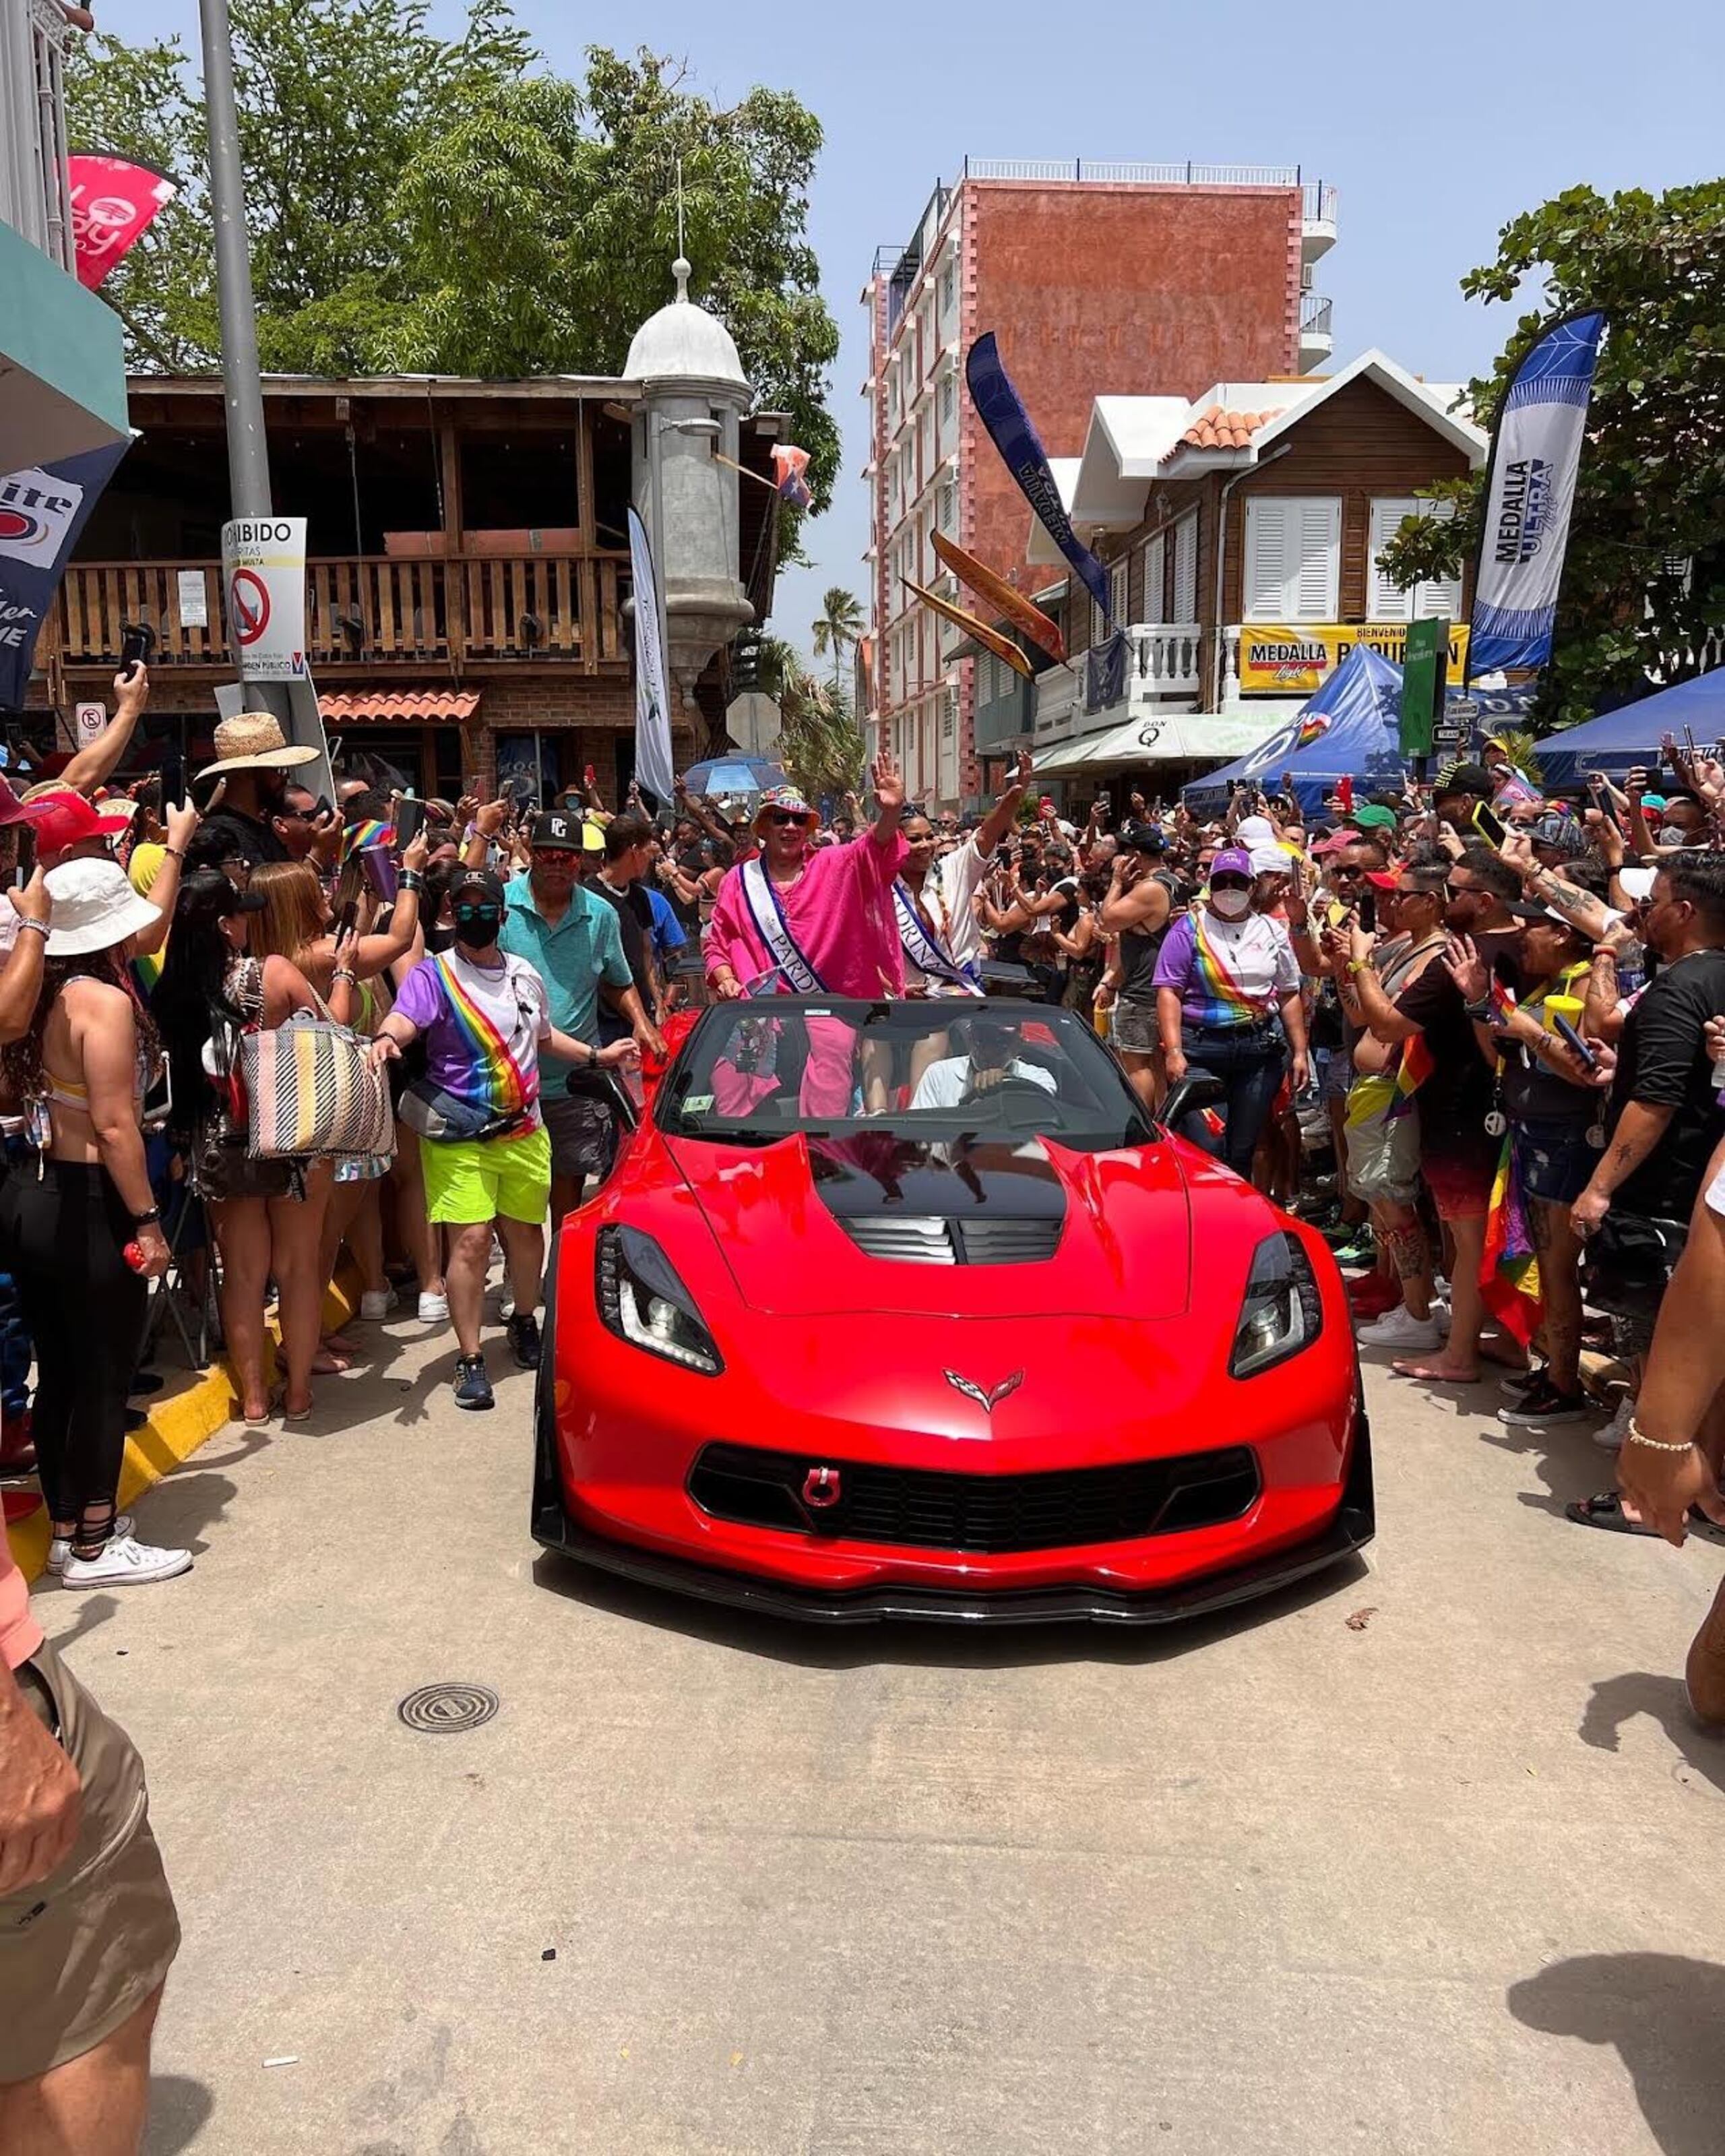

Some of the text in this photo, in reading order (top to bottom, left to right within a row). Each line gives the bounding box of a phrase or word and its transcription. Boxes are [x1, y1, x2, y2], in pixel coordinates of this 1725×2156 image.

[0, 482, 73, 518] ite
[1019, 461, 1069, 545] MEDALLA
[1495, 460, 1528, 563] MEDALLA
[1520, 461, 1554, 556] ULTRA
[1250, 644, 1327, 662] MEDALLA
[1138, 728, 1160, 747] Q
